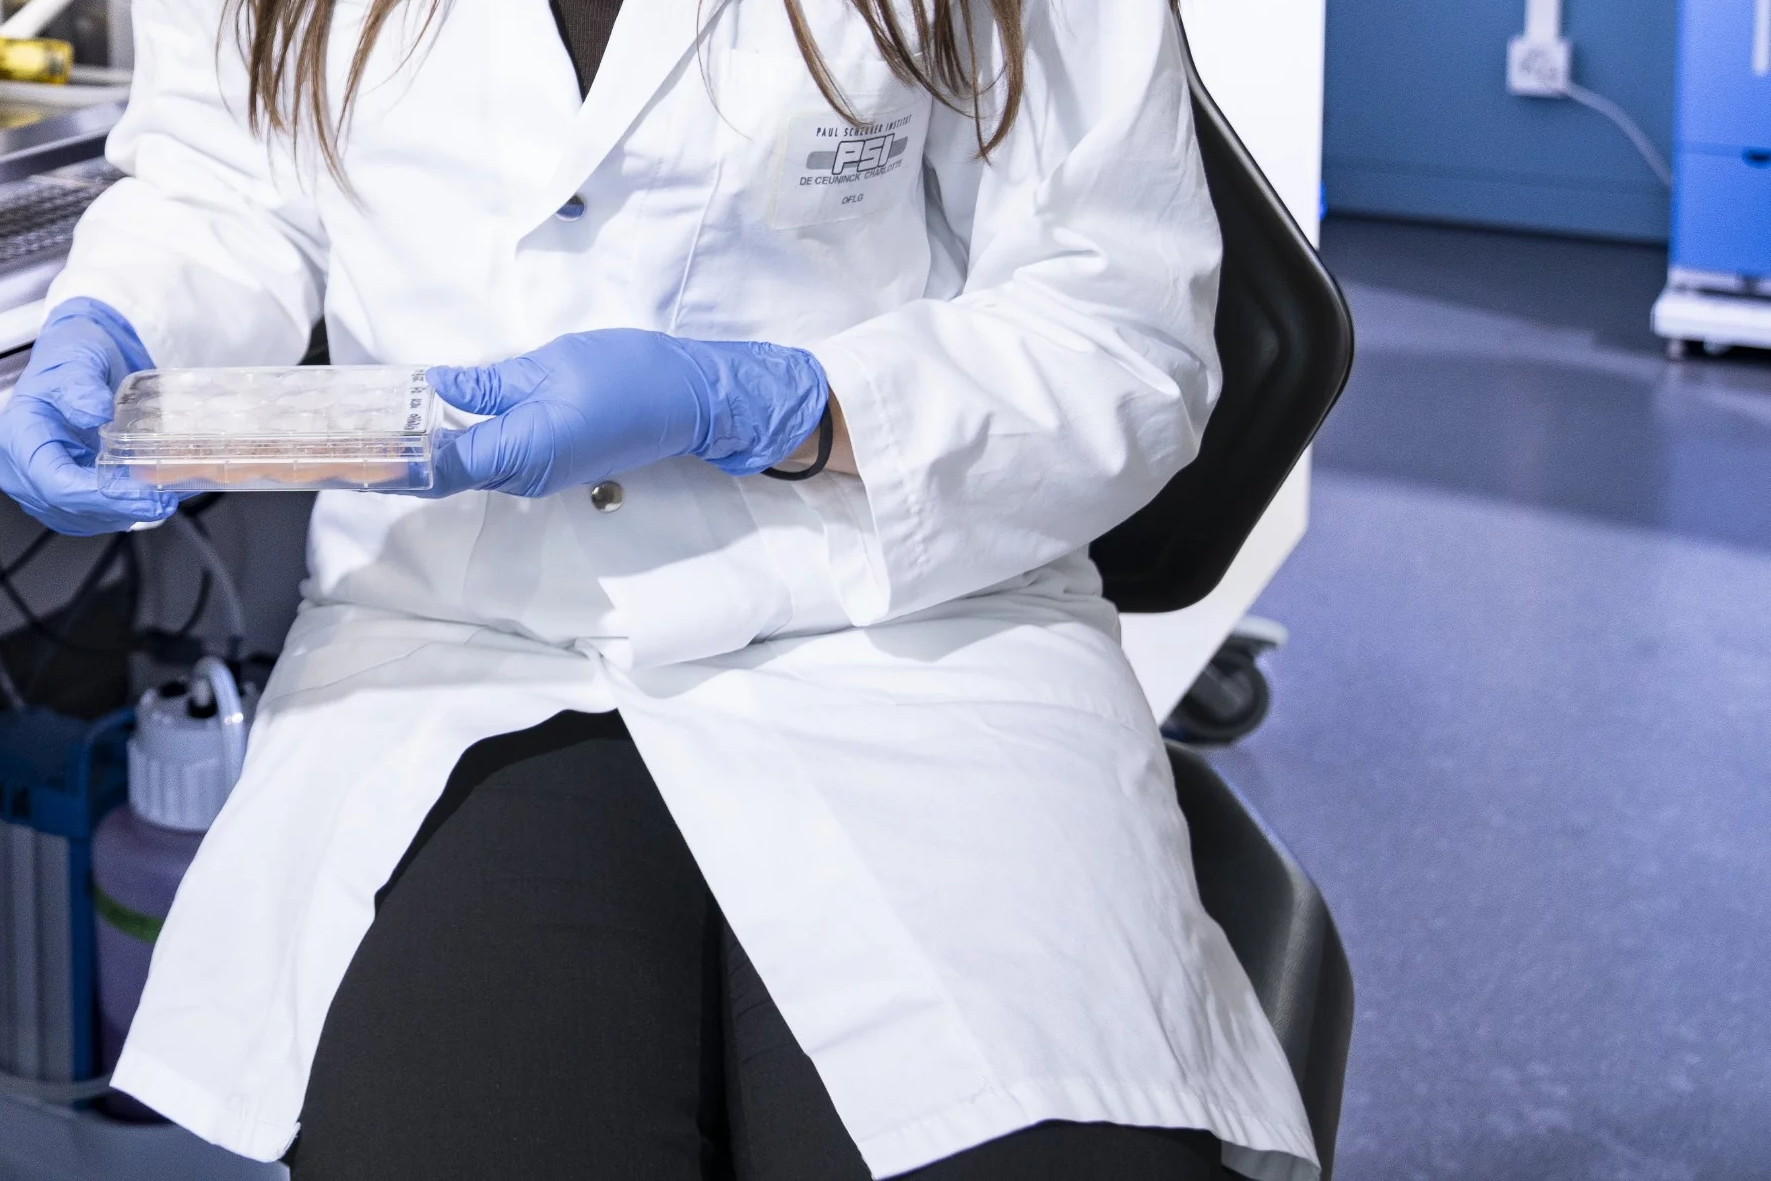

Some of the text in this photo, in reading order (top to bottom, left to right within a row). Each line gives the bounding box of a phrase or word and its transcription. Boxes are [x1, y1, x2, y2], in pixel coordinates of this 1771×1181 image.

[816, 114, 912, 138] PAUL SCHERRER INSTITUT
[831, 132, 896, 176] PSI
[799, 160, 902, 186] DE CEUNINCK CHARLOTTE
